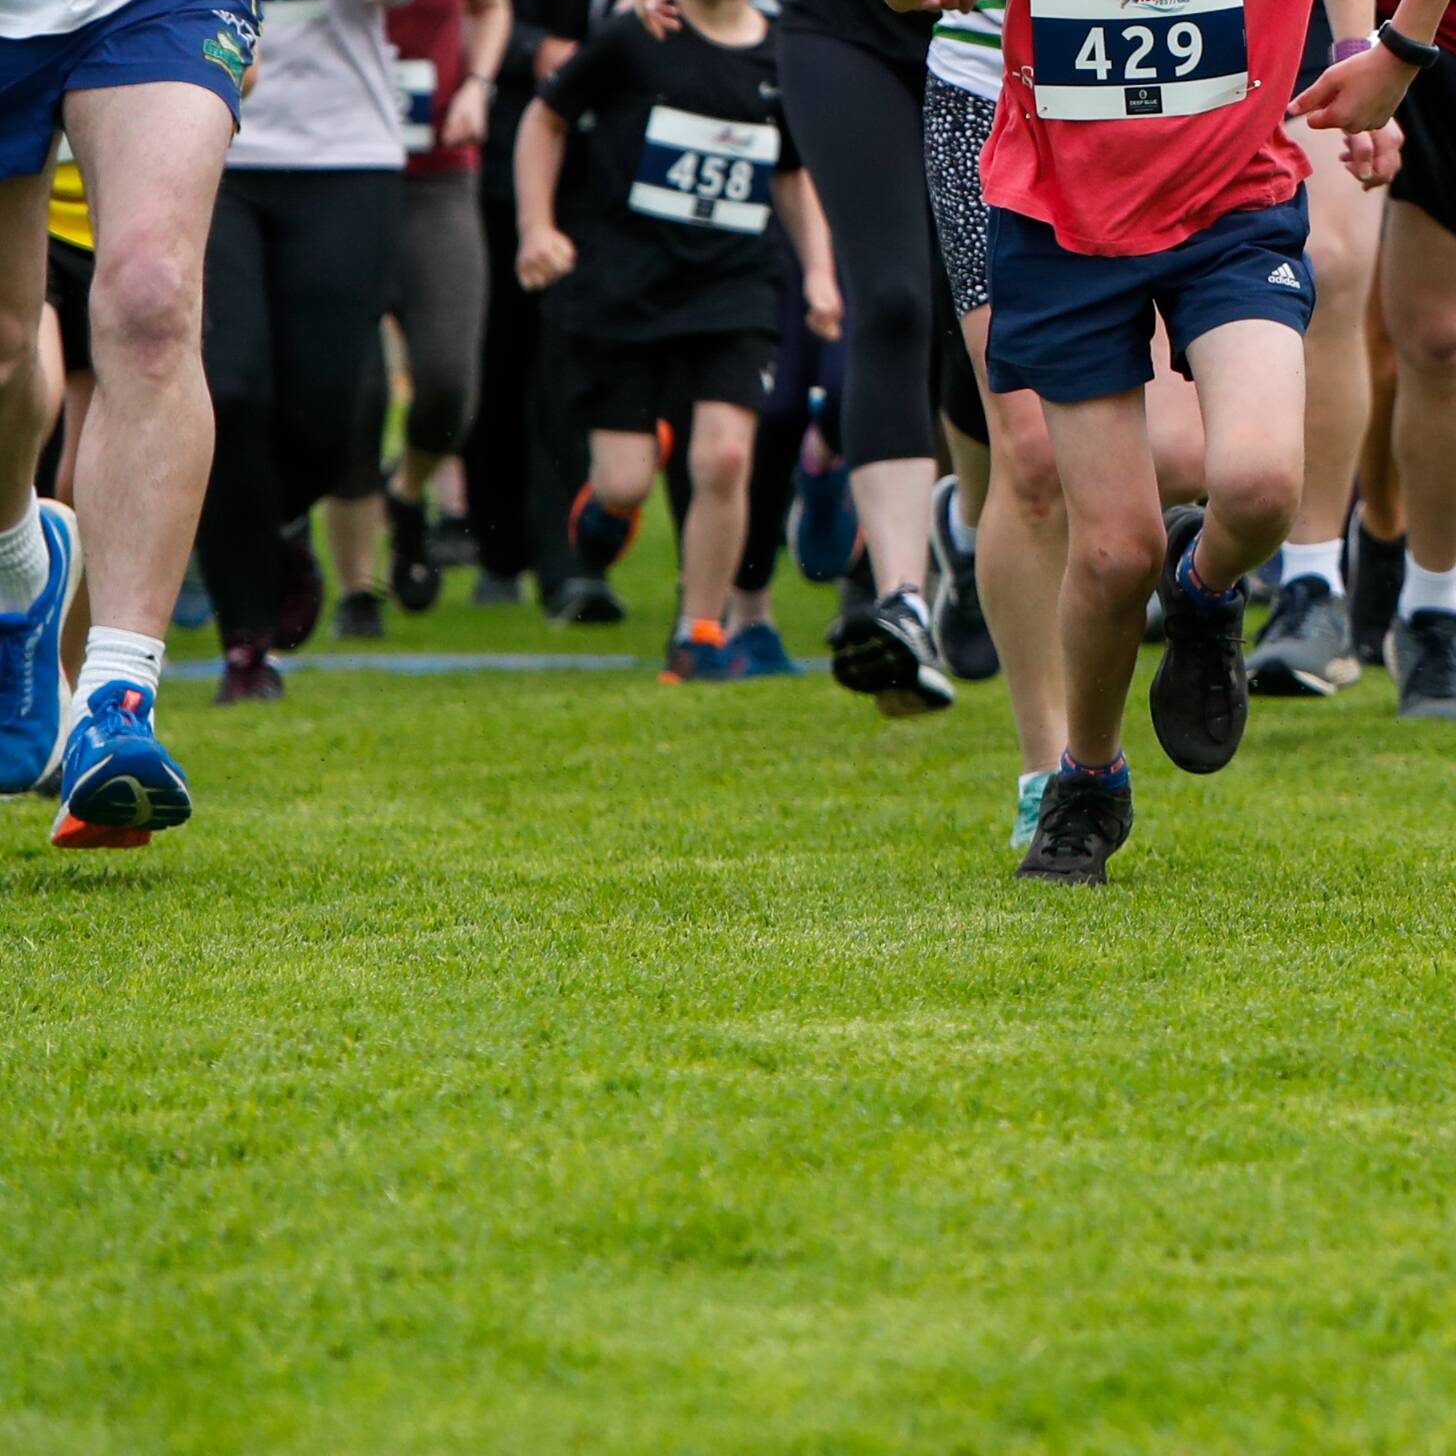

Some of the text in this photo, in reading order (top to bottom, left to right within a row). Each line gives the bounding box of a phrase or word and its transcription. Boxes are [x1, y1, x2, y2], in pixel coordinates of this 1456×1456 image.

[1075, 21, 1203, 80] 429
[666, 149, 755, 202] 458
[1268, 276, 1301, 289] adidas
